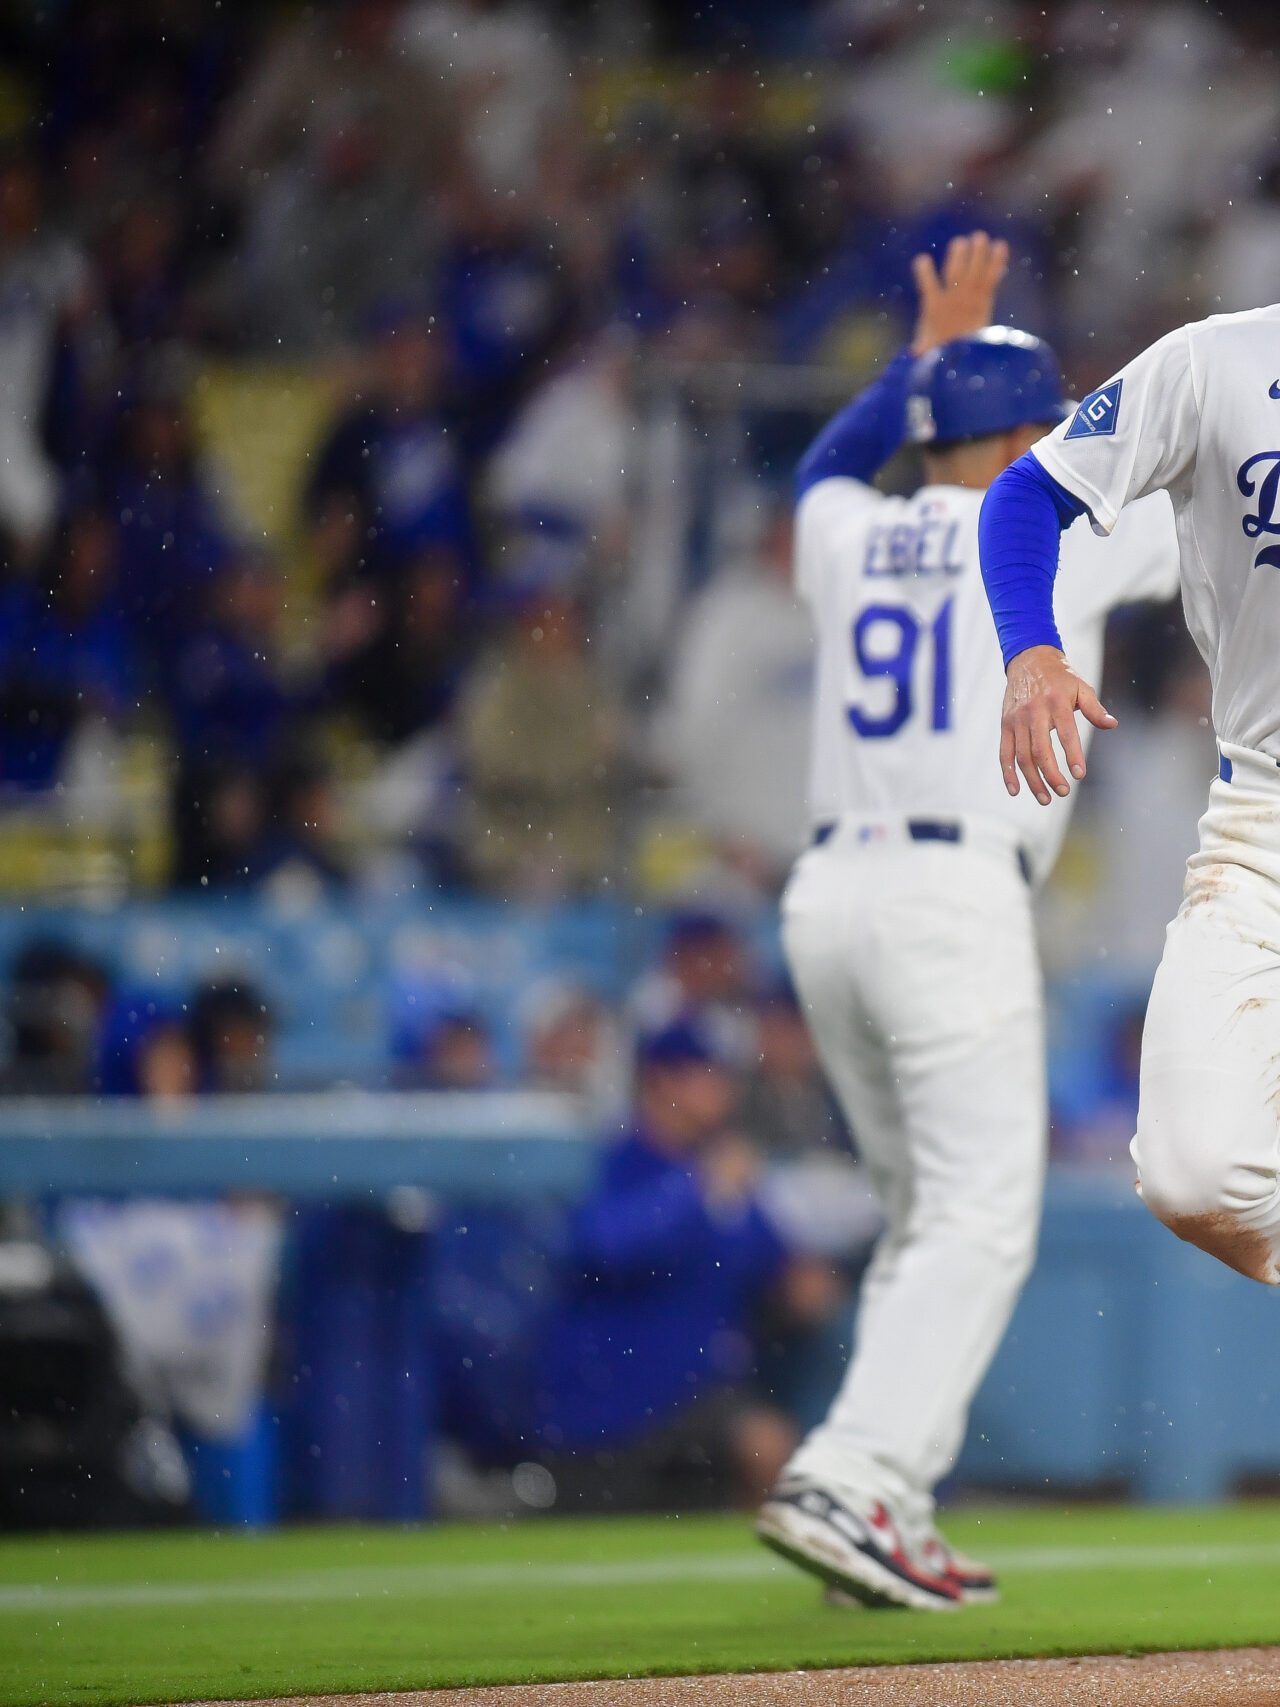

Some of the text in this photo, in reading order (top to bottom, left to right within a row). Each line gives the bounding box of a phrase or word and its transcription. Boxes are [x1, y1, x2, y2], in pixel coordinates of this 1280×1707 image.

[1087, 393, 1113, 422] G
[862, 519, 964, 580] EBEL
[846, 596, 955, 742] 91
